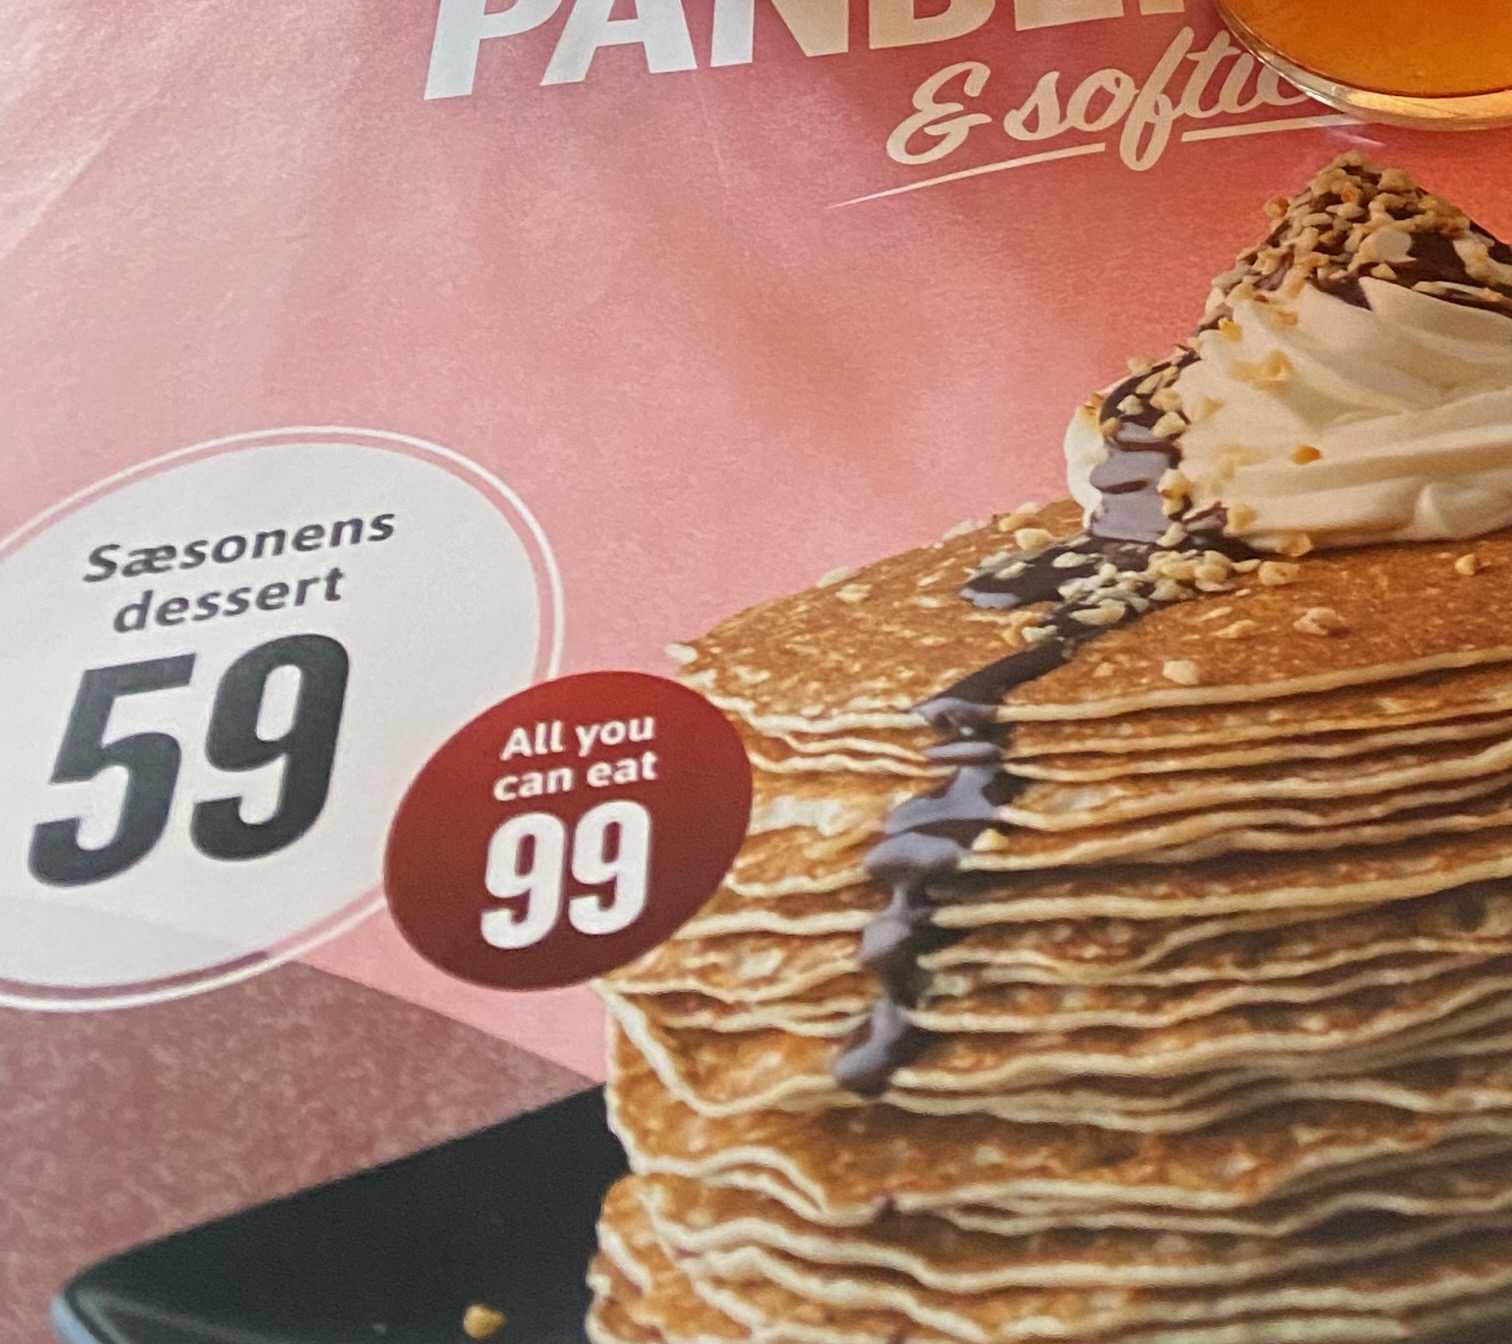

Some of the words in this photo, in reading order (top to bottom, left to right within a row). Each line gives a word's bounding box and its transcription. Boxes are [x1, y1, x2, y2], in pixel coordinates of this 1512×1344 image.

[886, 61, 994, 166] &
[82, 511, 397, 584] Sæsonens
[112, 565, 346, 634] dessert
[27, 633, 351, 888] 59
[501, 720, 564, 762] All
[577, 715, 656, 758] you
[491, 769, 574, 803] can
[586, 749, 659, 790] eat
[478, 799, 654, 951] 99
